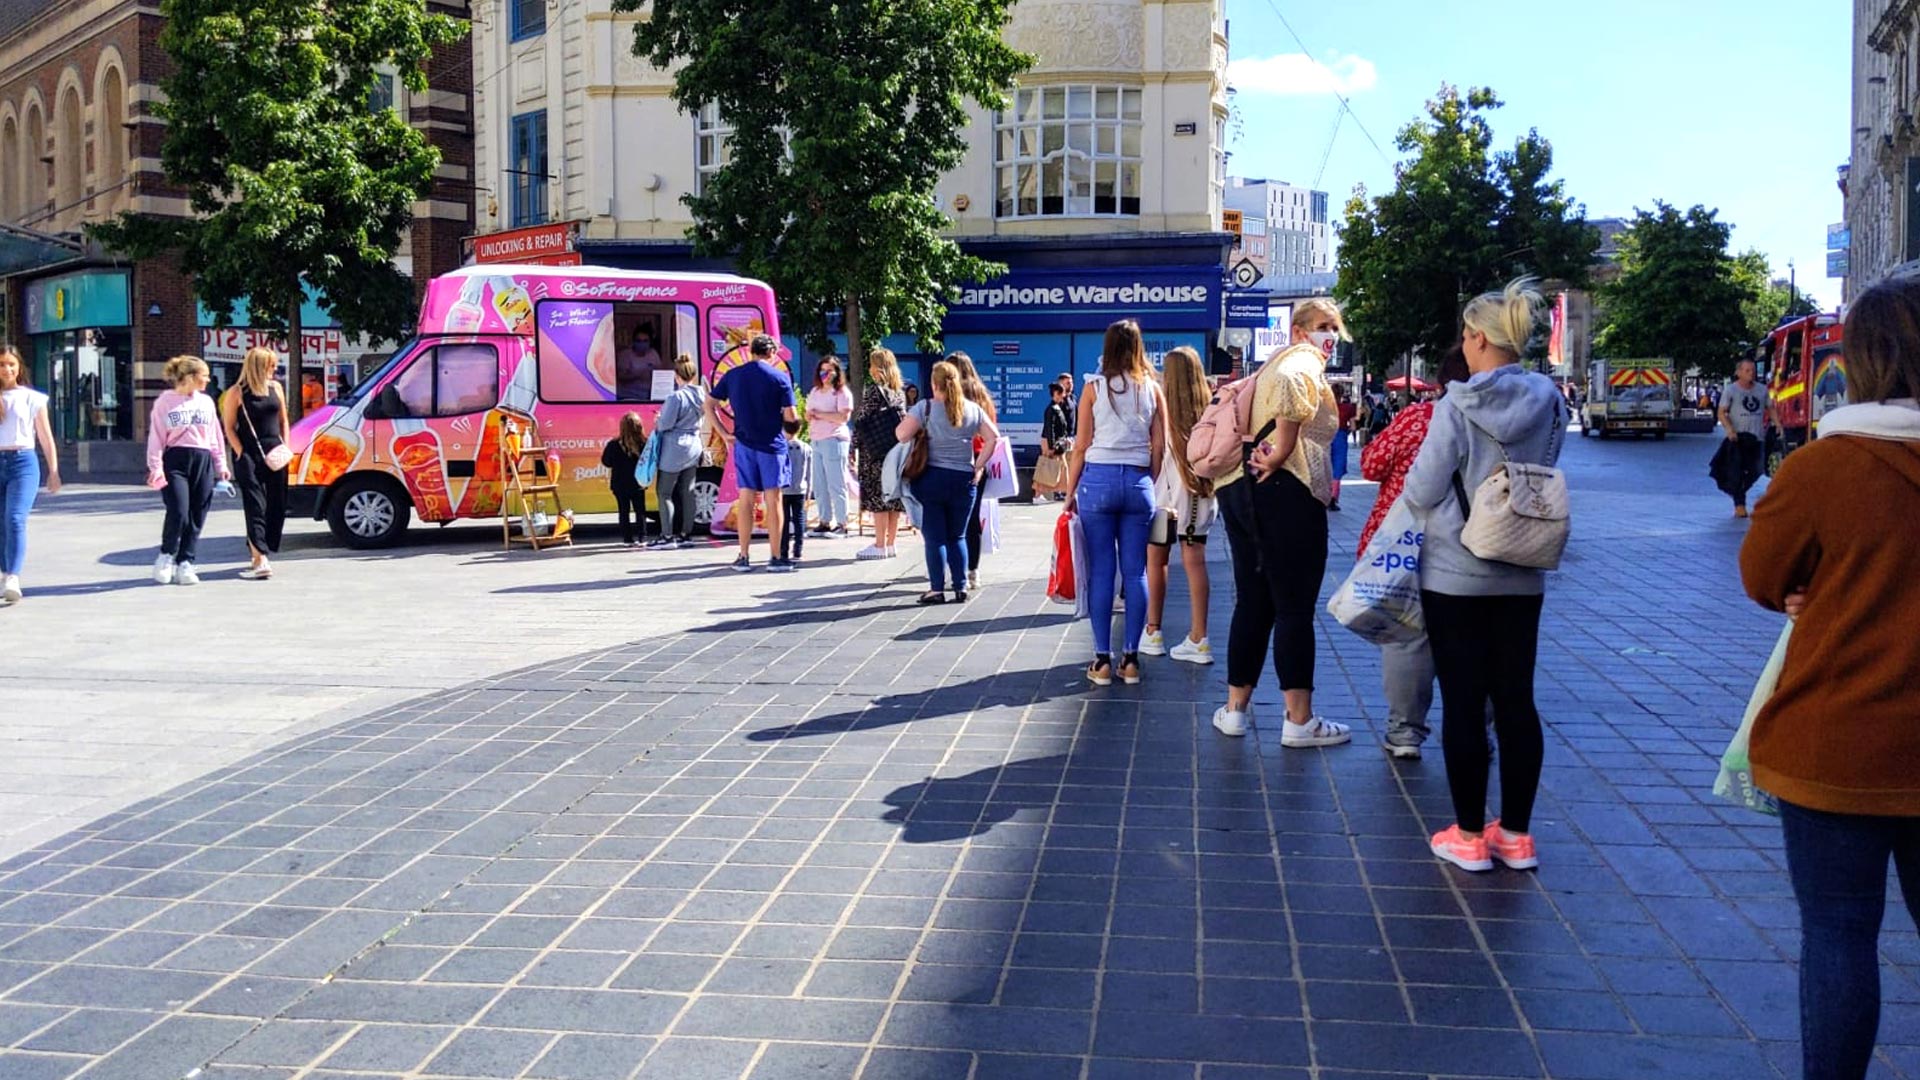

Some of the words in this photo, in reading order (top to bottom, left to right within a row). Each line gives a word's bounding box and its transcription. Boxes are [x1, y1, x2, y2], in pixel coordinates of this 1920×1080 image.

[481, 238, 525, 257] UNLOCKING
[526, 236, 533, 250] &
[535, 232, 563, 249] REPAIR
[560, 280, 679, 302] @SoFragrance
[702, 286, 725, 299] Body
[1067, 283, 1207, 304] Warehouse
[544, 438, 595, 449] DISCOVER
